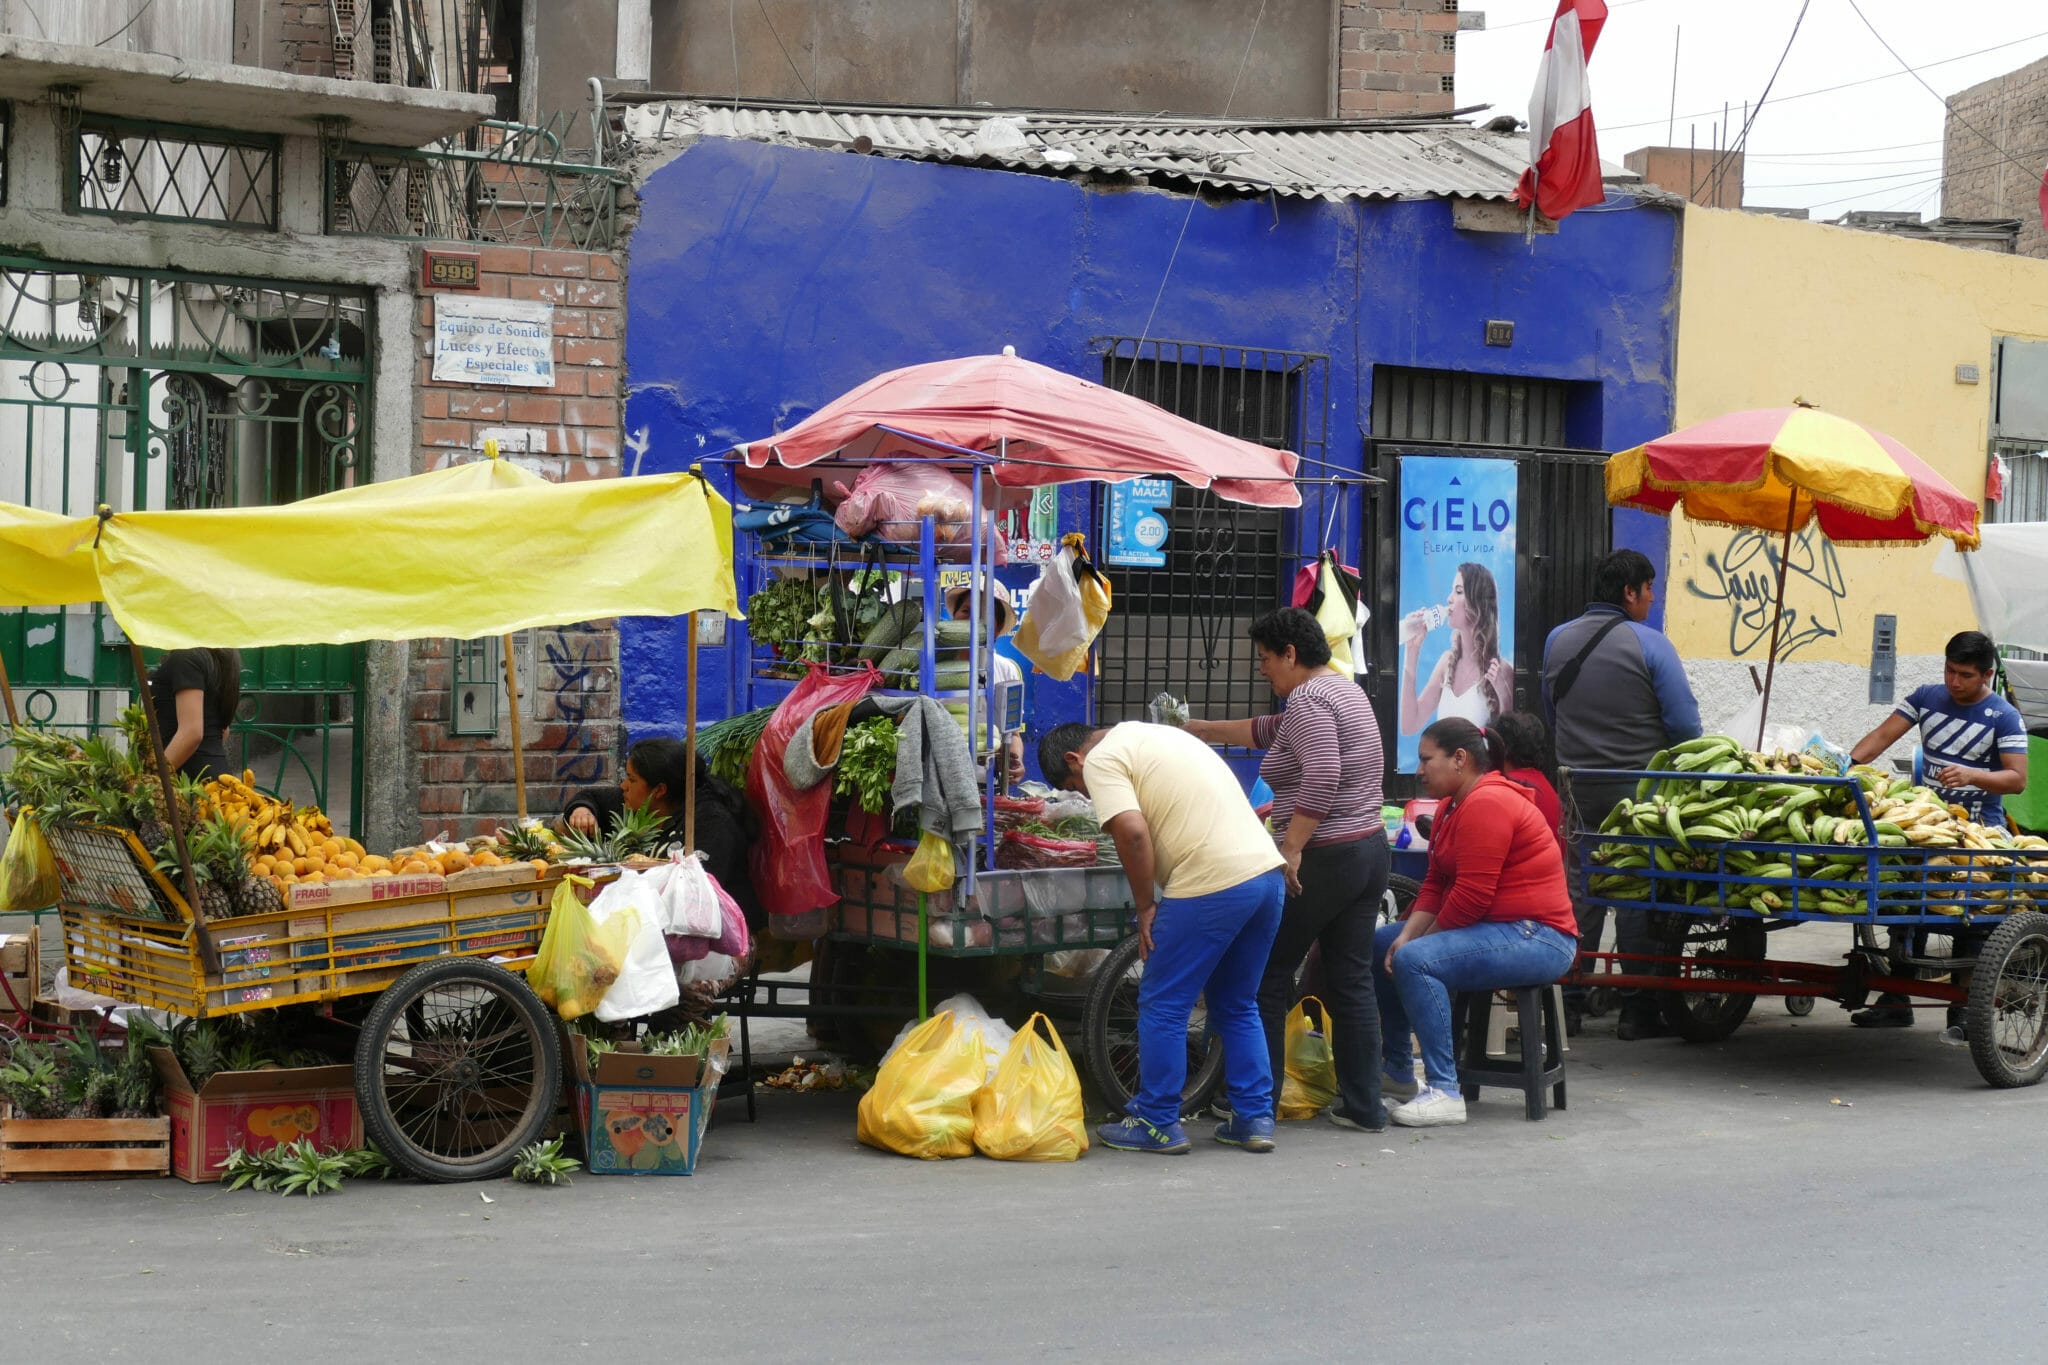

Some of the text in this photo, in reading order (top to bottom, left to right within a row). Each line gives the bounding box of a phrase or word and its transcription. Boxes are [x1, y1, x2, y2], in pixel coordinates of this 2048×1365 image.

[433, 264, 475, 280] 998
[439, 320, 549, 339] Equipo de Sonido
[440, 339, 546, 357] Luces y Efectos
[465, 357, 529, 373] Especiales
[1132, 487, 1168, 498] MACA
[1404, 496, 1510, 533] CIELO
[1140, 525, 1161, 537] 2.00
[295, 887, 331, 900] FRAGIL
[1147, 1127, 1170, 1144] AIR
